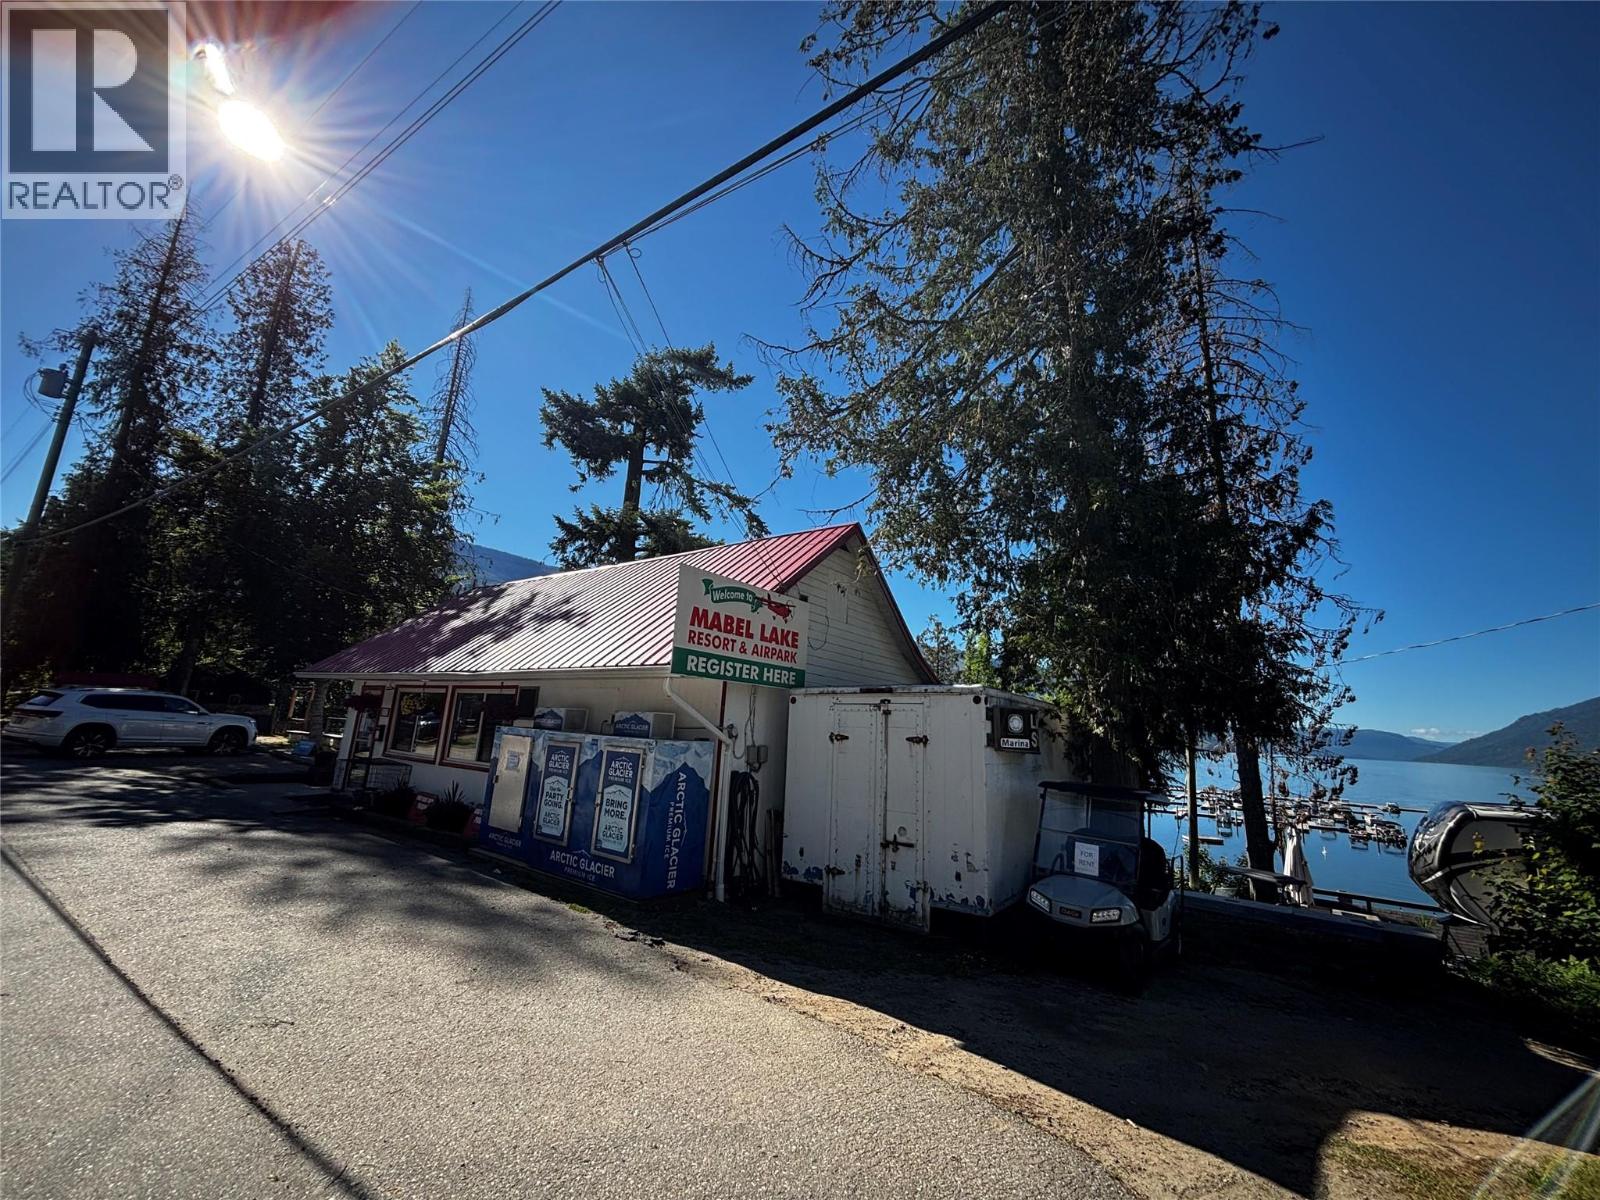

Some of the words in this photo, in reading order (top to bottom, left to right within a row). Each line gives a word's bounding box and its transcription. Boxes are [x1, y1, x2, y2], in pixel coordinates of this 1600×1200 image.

[712, 589, 745, 601] Welcome
[746, 592, 753, 602] to
[689, 606, 754, 640] MABEL
[759, 623, 799, 649] LAKE
[687, 630, 737, 652] RESORT
[739, 641, 748, 654] &
[751, 643, 797, 664] AIRPARK
[686, 655, 759, 681] REGISTER
[763, 667, 796, 685] HERE
[1002, 739, 1029, 748] Marina
[551, 753, 570, 763] ARCTIC
[549, 761, 570, 770] GLACIER
[610, 760, 633, 770] ARCTIC
[608, 768, 633, 778] GLACIER
[545, 791, 564, 801] PARTY
[673, 771, 687, 824] ARCTIC
[543, 800, 563, 809] GOING.
[605, 798, 628, 809] BRING
[604, 809, 627, 820] MORE.
[542, 817, 560, 826] GLACIER
[665, 801, 675, 842] PREMIUM
[604, 824, 623, 834] ARCTIC
[602, 830, 624, 841] GLACIER
[666, 828, 682, 889] GLACIER
[549, 850, 578, 868] ARCTIC
[579, 858, 616, 879] GLACIER
